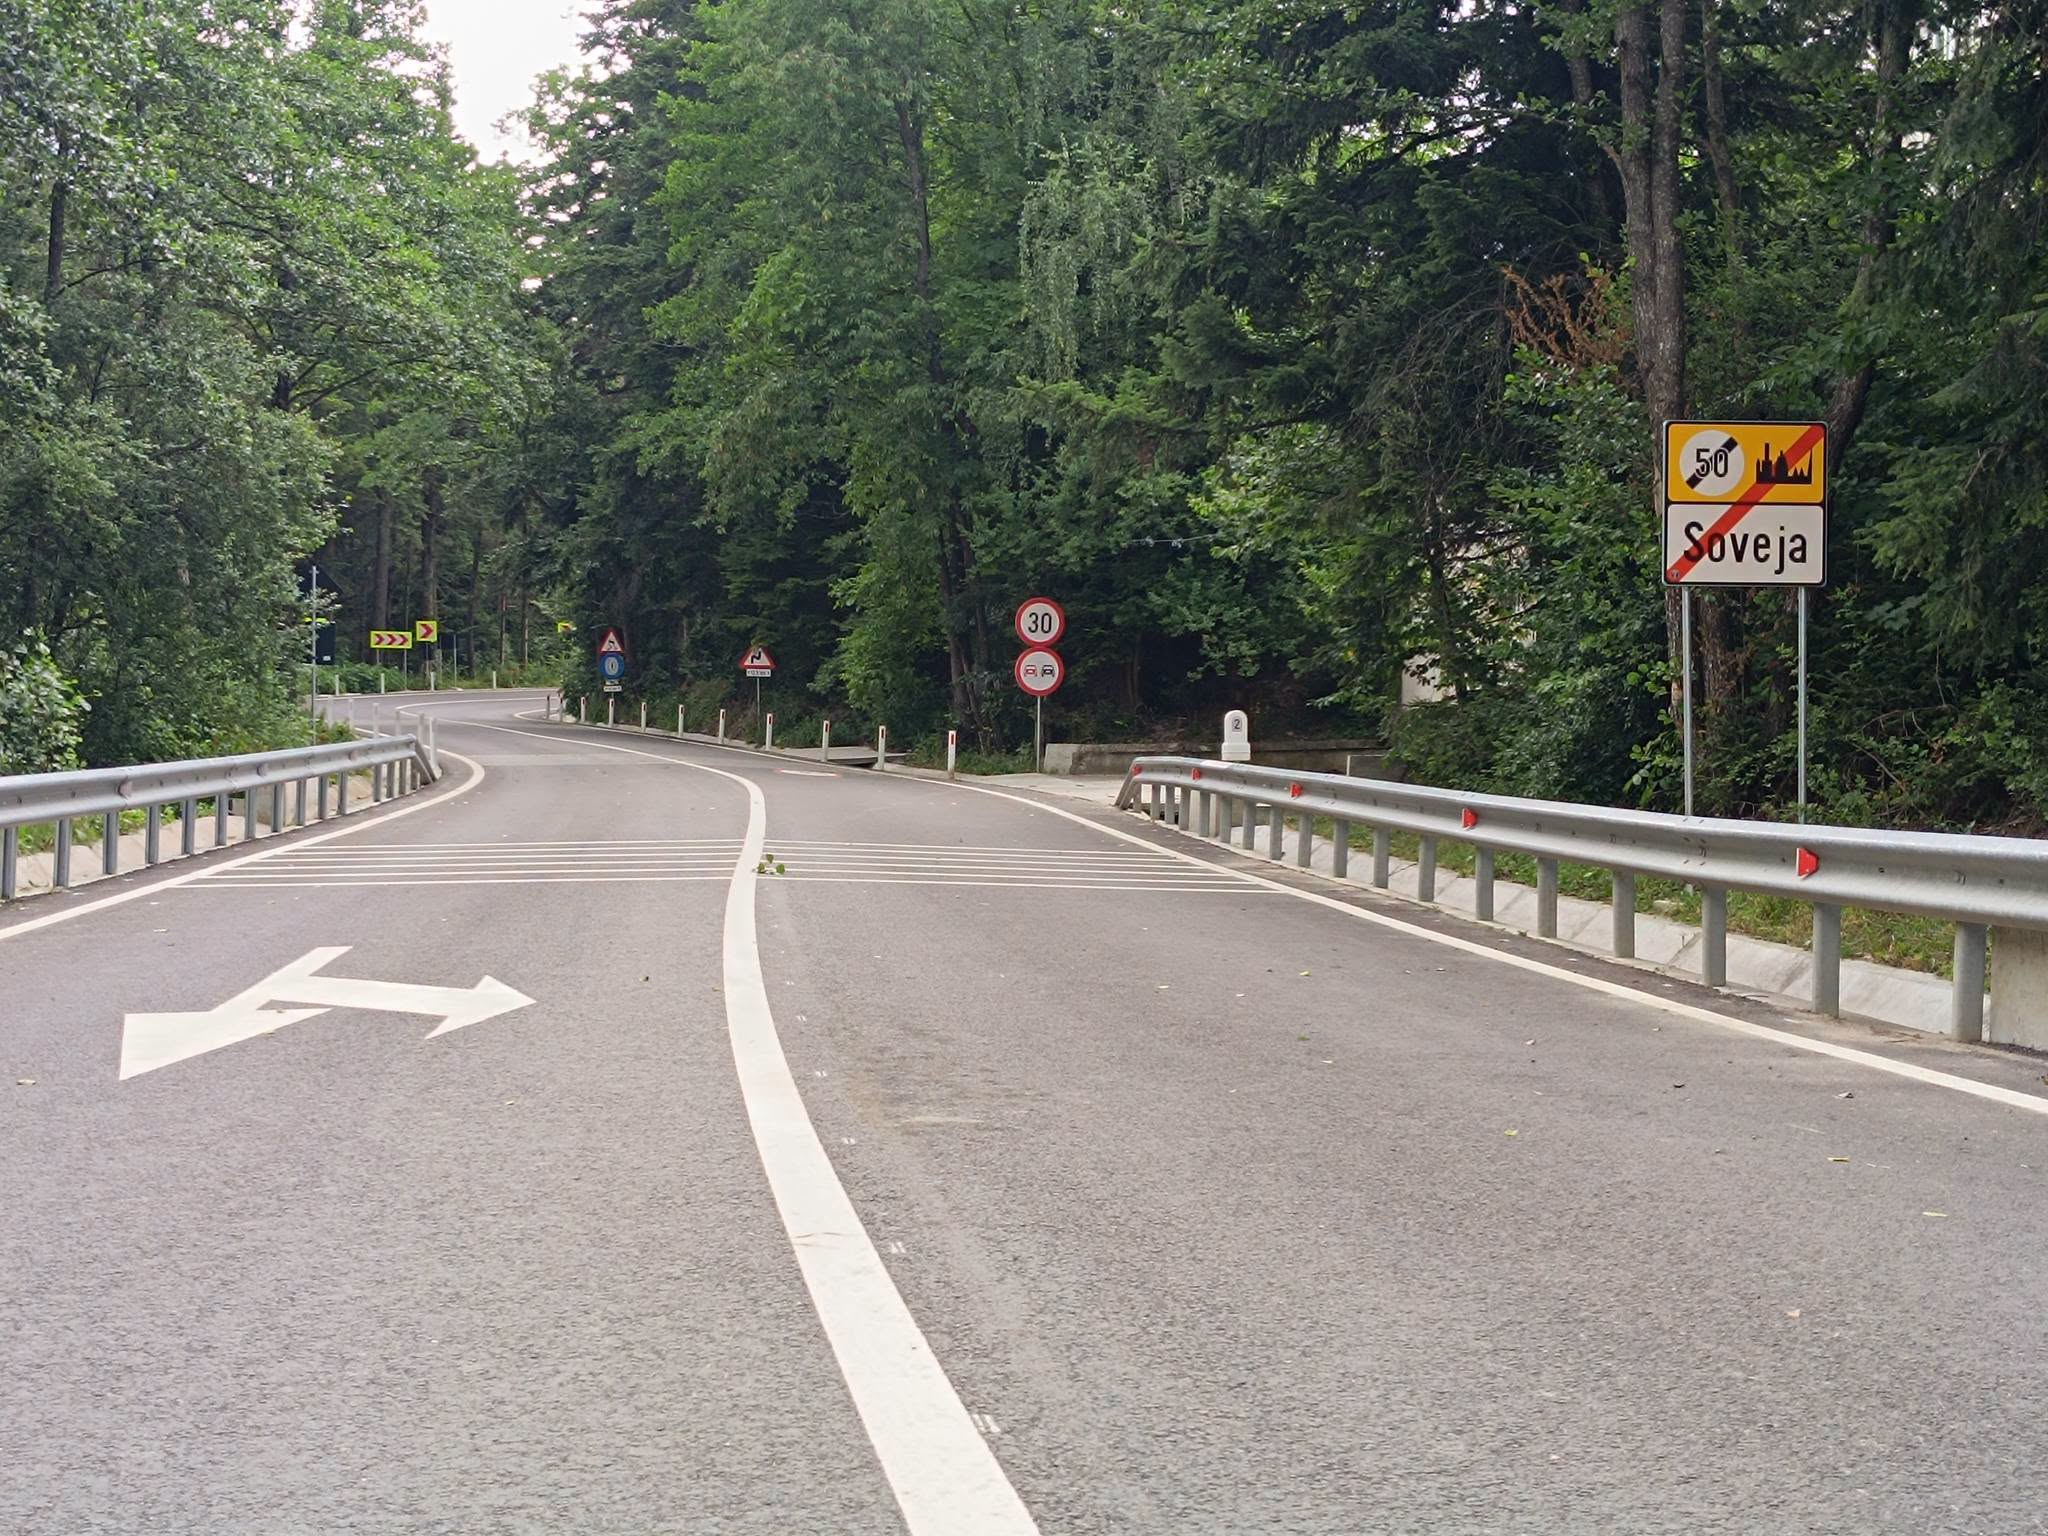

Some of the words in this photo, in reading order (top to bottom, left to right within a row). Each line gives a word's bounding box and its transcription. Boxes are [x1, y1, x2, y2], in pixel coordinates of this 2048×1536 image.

[1696, 448, 1729, 478] 50
[1683, 521, 1807, 575] Soveja
[1028, 612, 1052, 634] 30
[1233, 718, 1241, 730] 2
